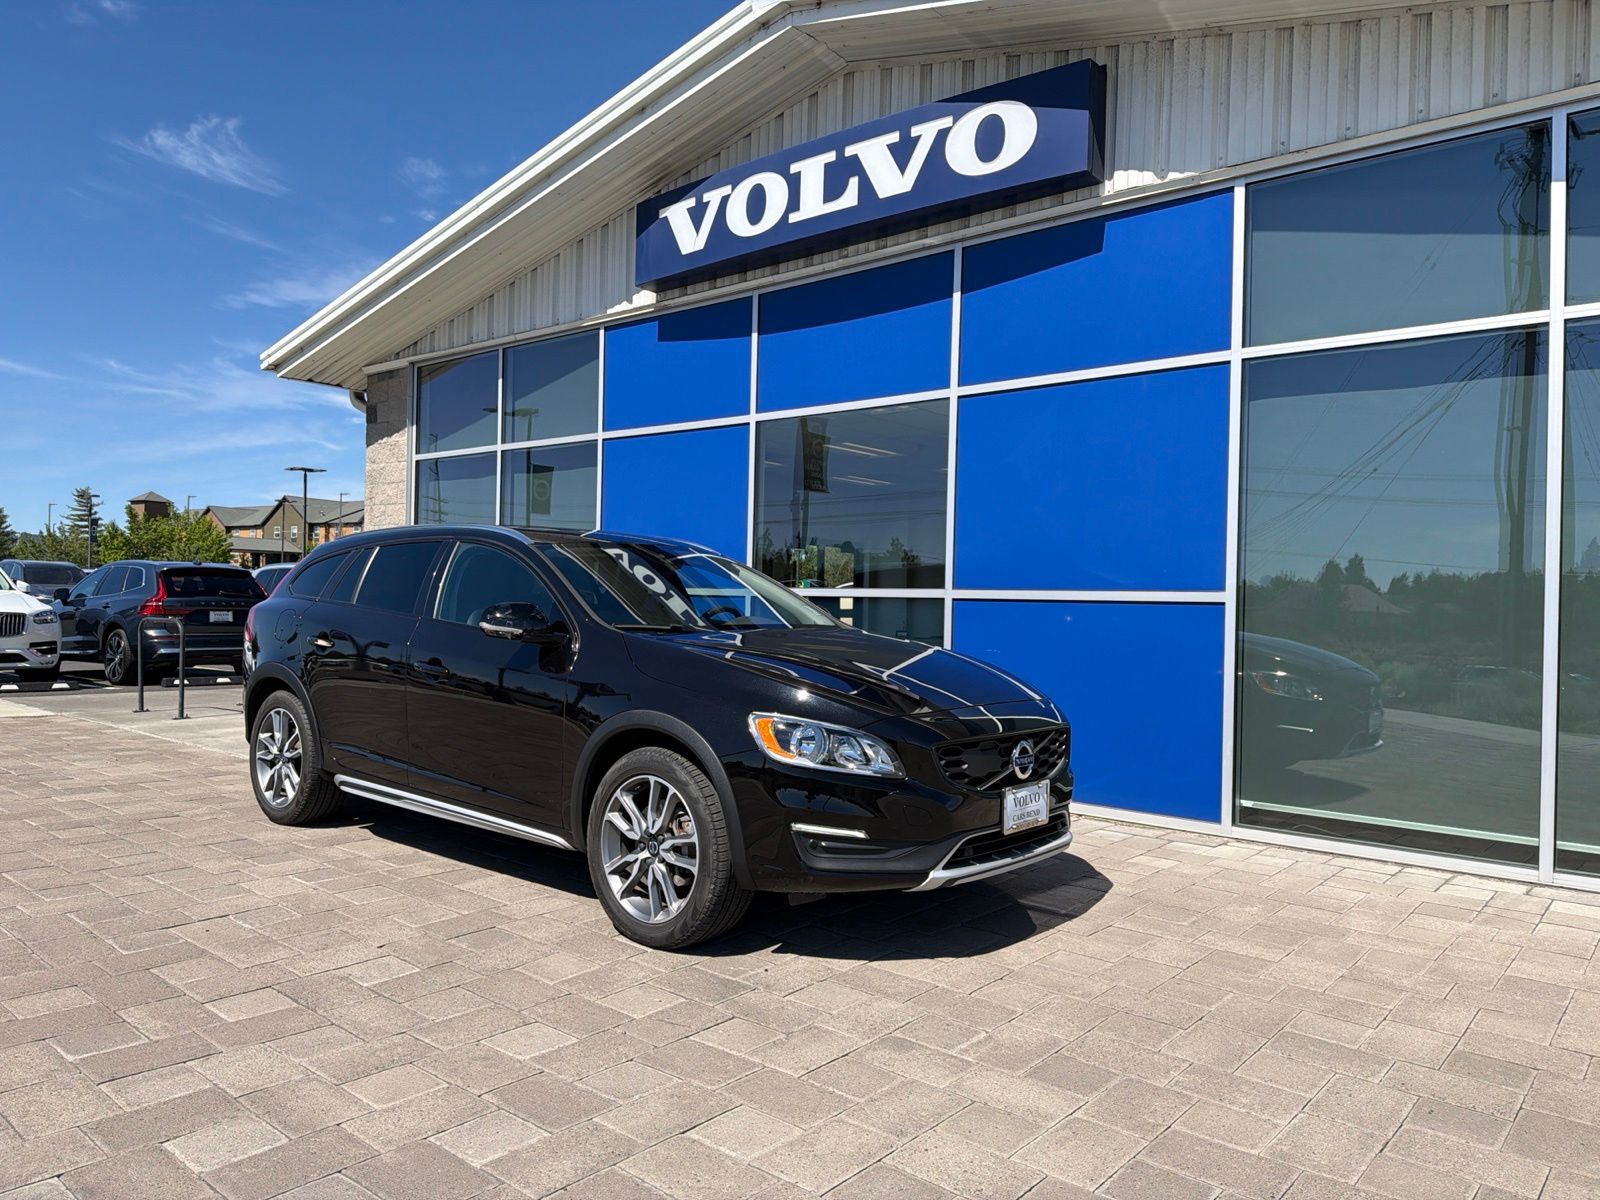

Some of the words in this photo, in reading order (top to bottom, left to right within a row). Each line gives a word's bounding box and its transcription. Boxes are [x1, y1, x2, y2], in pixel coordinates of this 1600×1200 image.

[659, 100, 1038, 255] VOLVO
[1013, 792, 1040, 808] VOLVO
[1012, 812, 1026, 822] CARS
